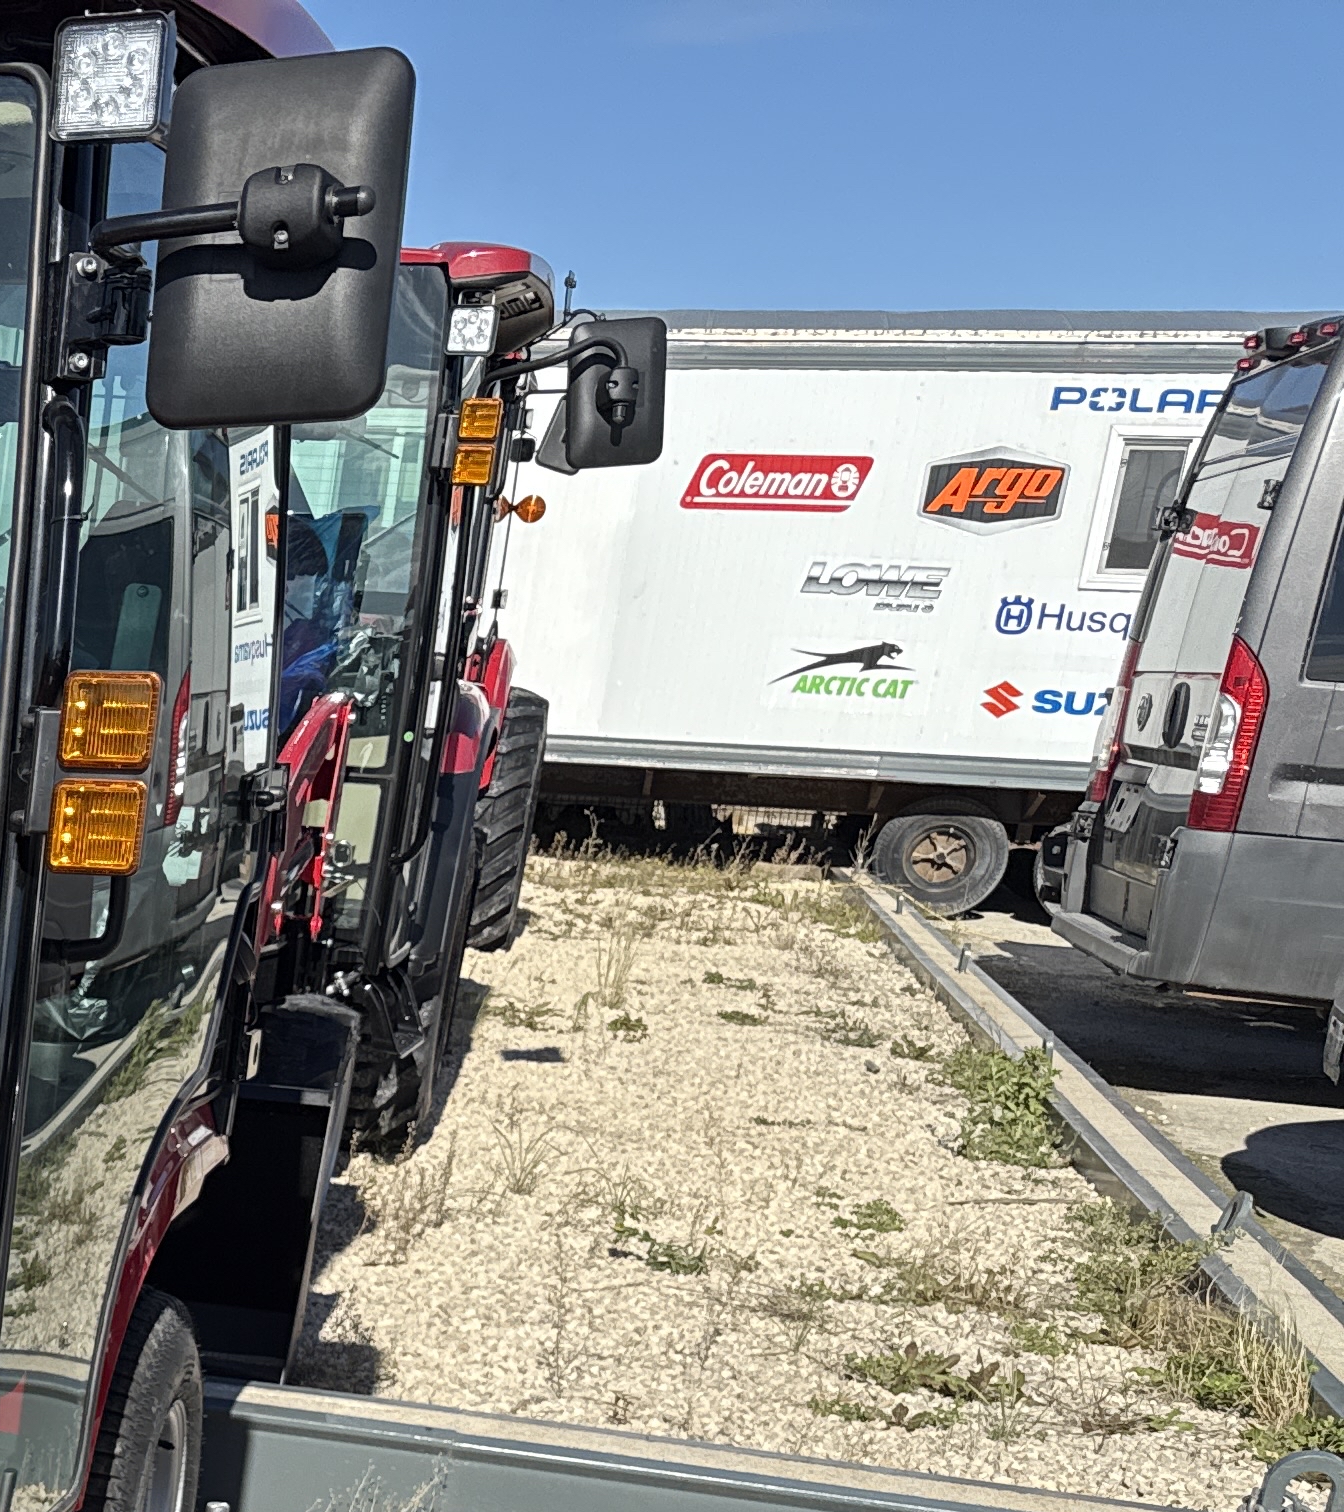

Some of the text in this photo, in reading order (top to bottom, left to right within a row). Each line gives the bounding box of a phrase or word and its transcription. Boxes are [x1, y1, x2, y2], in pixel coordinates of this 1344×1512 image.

[699, 460, 824, 497] Coleman
[925, 467, 1066, 514] Argo
[800, 561, 952, 600] LOWE
[791, 674, 915, 699] ARCTIC CAT
